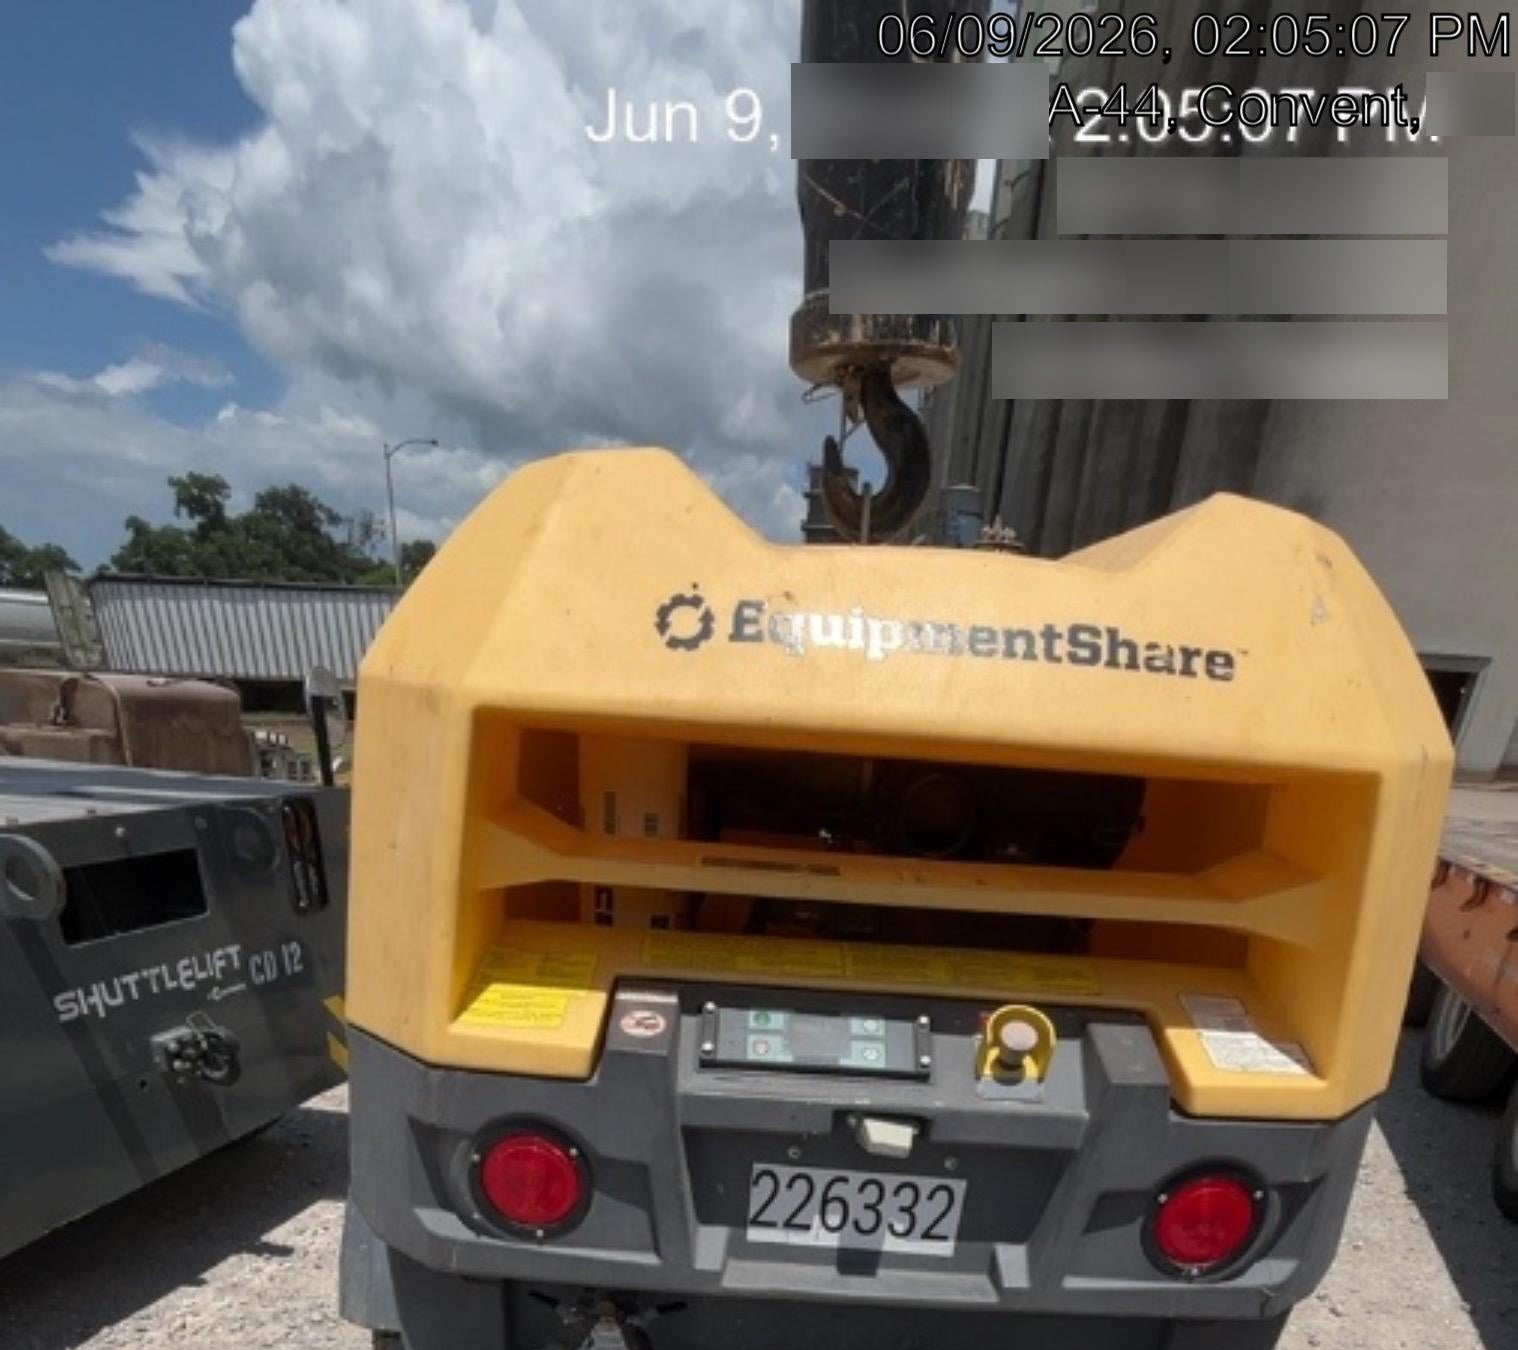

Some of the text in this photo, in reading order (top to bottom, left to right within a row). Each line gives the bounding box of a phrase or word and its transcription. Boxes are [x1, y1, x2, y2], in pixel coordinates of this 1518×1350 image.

[728, 599, 1236, 682] EquipmentShare
[54, 941, 304, 1022] SHUTTLELIFT CD 12
[750, 1169, 956, 1241] 226332
